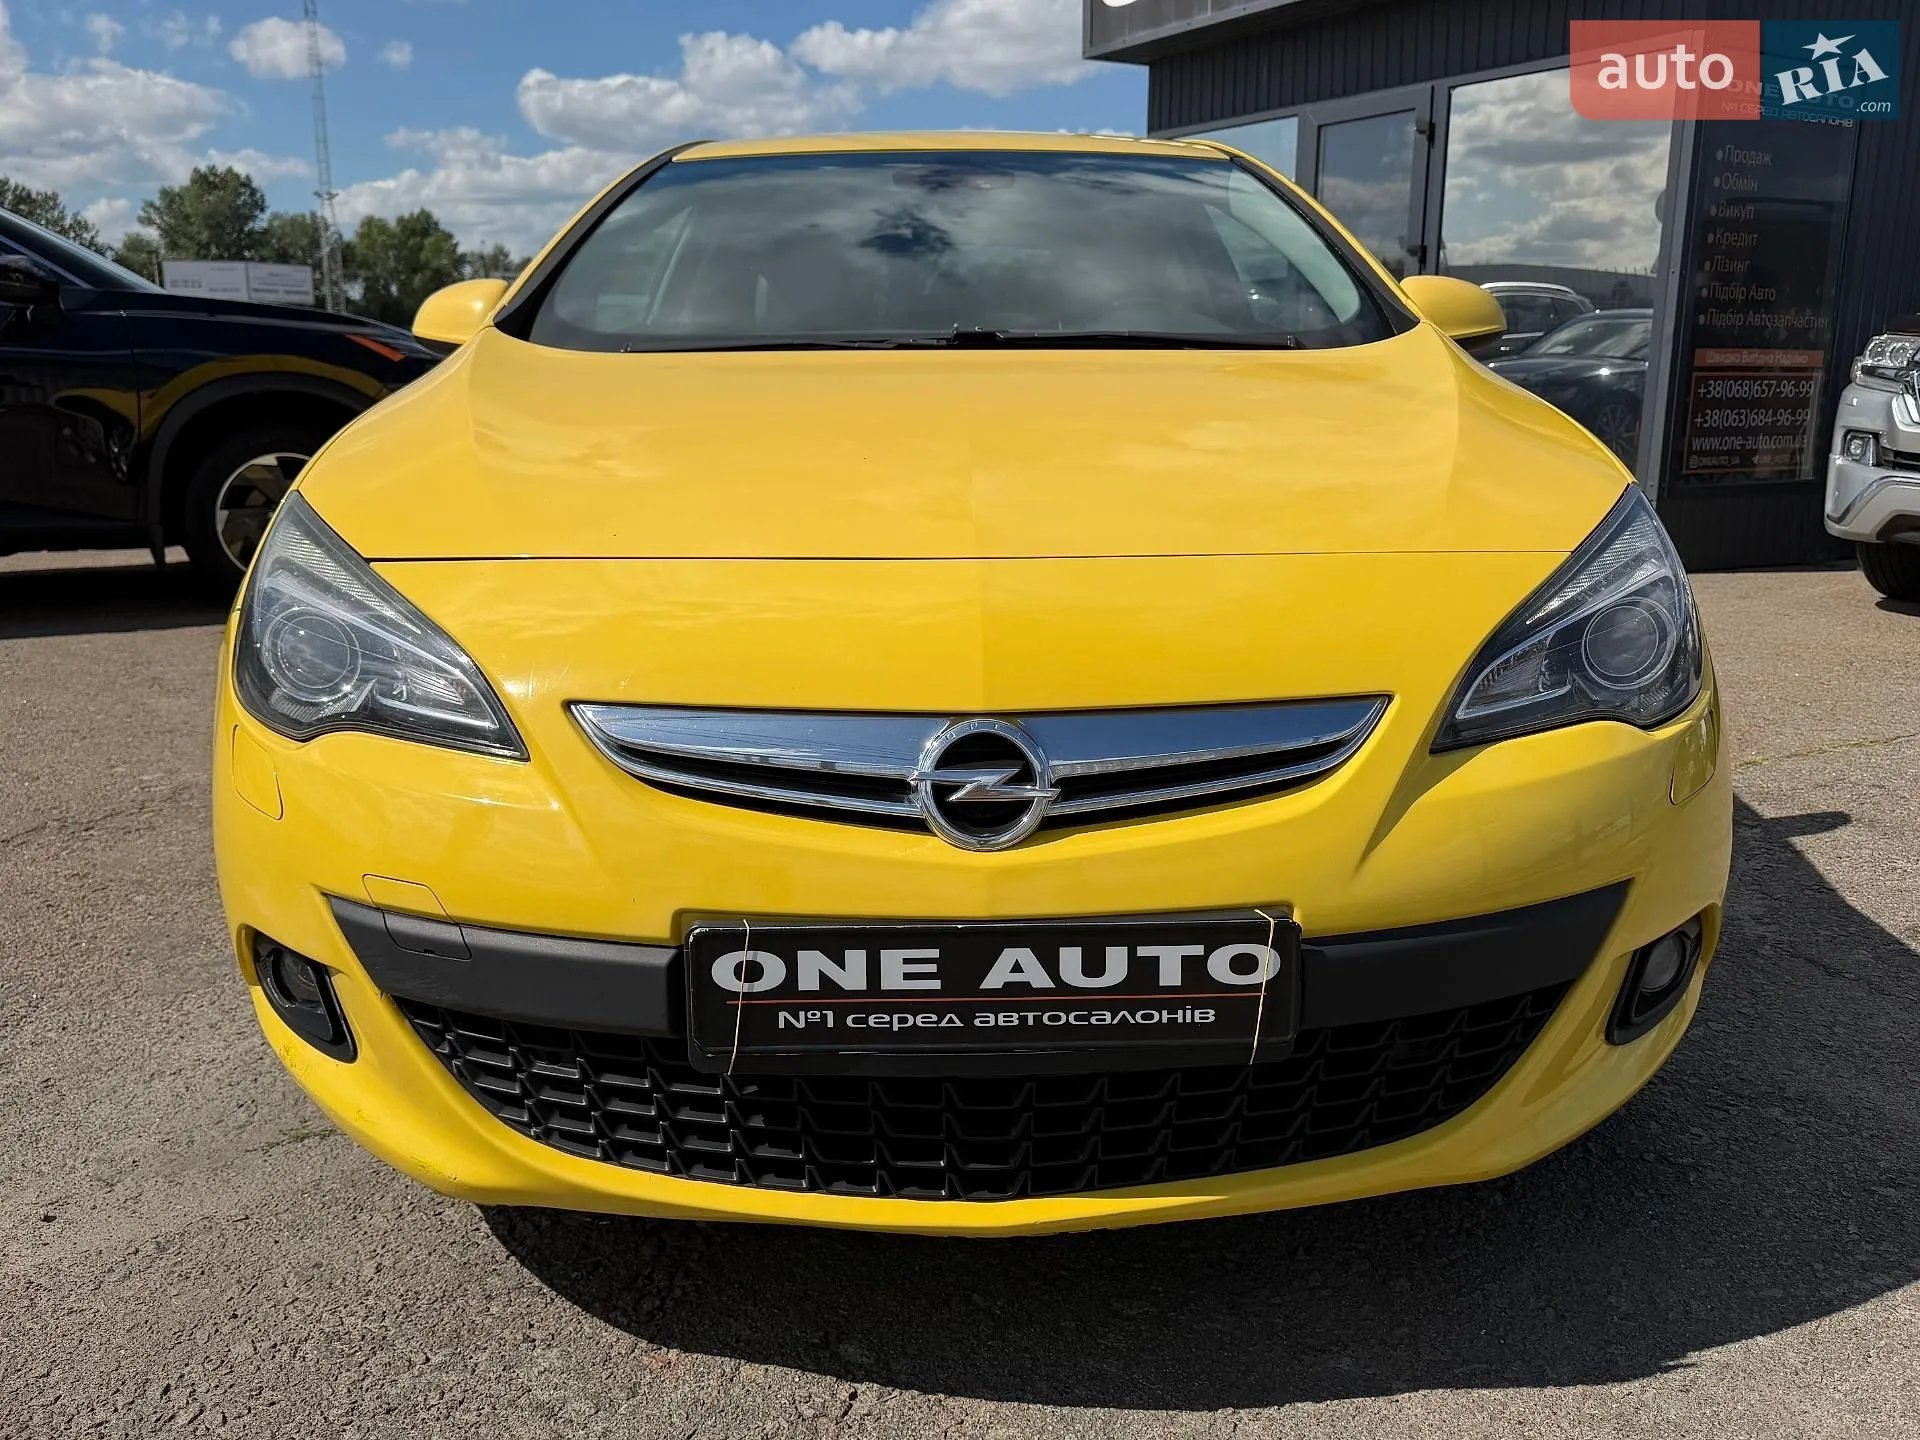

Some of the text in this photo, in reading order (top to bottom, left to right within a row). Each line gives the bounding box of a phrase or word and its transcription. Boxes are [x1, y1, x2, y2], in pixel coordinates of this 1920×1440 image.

[1725, 144, 1773, 167] Продаж
[1722, 172, 1758, 191] Обмін
[1718, 201, 1755, 222] Викуп
[1715, 228, 1759, 248] Кредит
[1711, 255, 1751, 272] Лізинг
[1709, 281, 1776, 303] Підбір Авто
[1706, 308, 1744, 330] Підбір
[1697, 379, 1814, 400] +38(068)657-96-99
[1694, 408, 1810, 429] +38(063)684-96-99
[1692, 433, 1808, 451] www.one-auto.com.ua
[710, 943, 1281, 993] ONE AUTO
[845, 1011, 964, 1032] серед
[973, 1006, 1216, 1028] автосалонів
